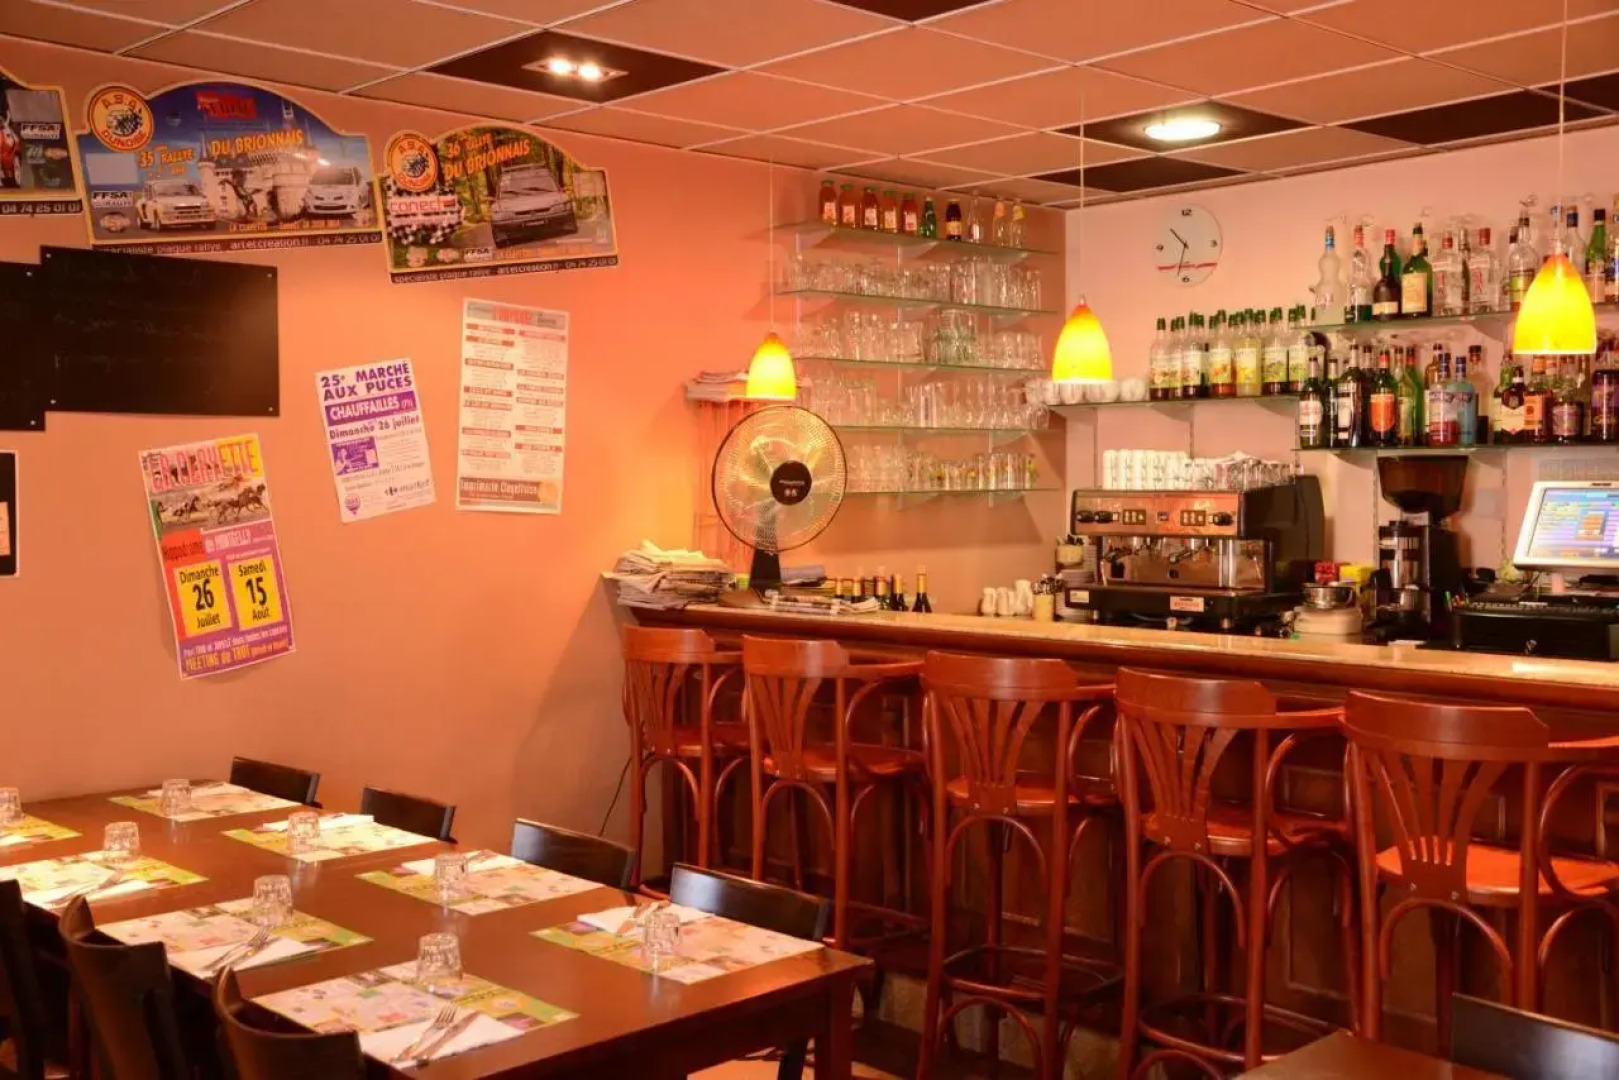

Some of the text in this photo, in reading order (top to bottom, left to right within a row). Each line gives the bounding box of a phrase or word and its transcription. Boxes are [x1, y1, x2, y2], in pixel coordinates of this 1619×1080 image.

[211, 129, 304, 157] DU BRIONNAIS
[444, 139, 531, 181] DU BRIONNAIS
[92, 191, 129, 200] FFSA
[1, 204, 17, 214] 04
[36, 203, 51, 213] 25
[1181, 208, 1193, 217] 12
[355, 361, 410, 383] MARCHÉ
[323, 375, 412, 401] AUX PUCES
[329, 395, 400, 420] CHAUFFAILLES
[329, 422, 375, 440] Dimanche
[378, 419, 391, 431] 26
[392, 415, 420, 431] juillet
[179, 563, 220, 585] Dimanche
[238, 558, 267, 577] Samedi
[192, 578, 215, 611] 26
[245, 576, 267, 606] 15
[196, 612, 221, 629] Juillet
